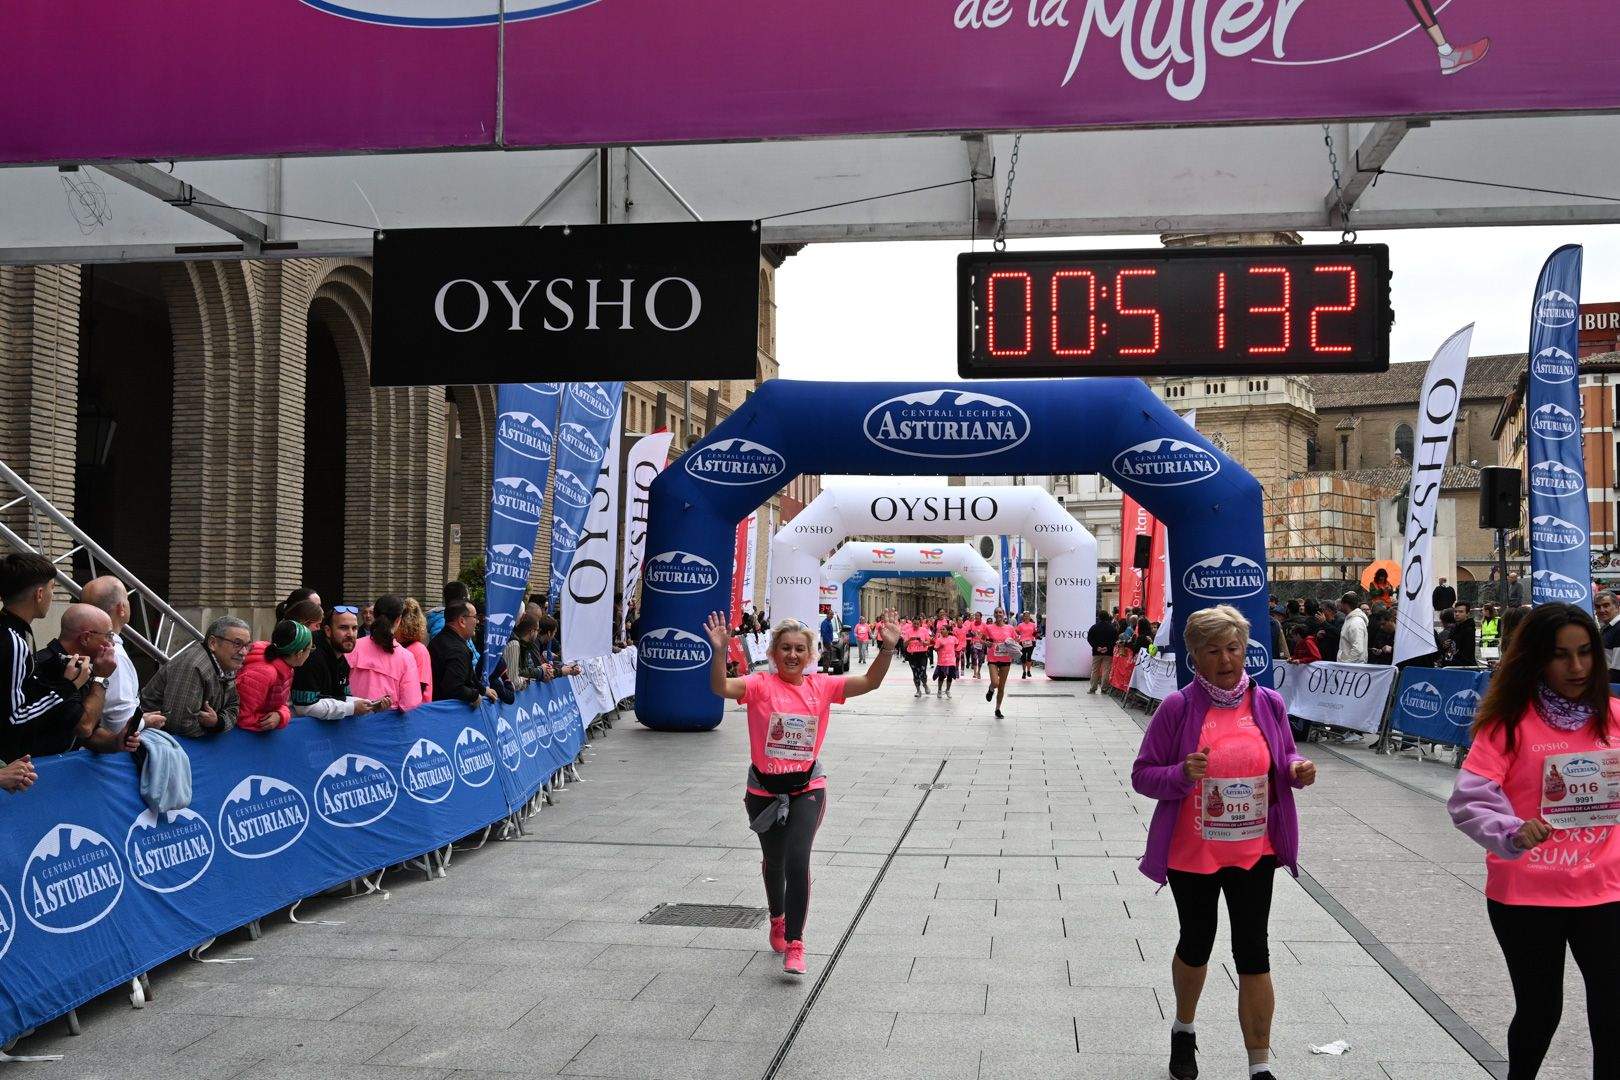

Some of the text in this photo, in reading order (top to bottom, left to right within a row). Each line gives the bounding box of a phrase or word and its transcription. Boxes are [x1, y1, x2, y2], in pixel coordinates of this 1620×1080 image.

[434, 276, 702, 333] OYSHO
[1535, 361, 1573, 375] ASTURIANA
[571, 383, 610, 416] ASTURIANA
[901, 409, 1012, 418] CENTRAL LECHERA
[1533, 415, 1572, 432] ASTURIANA
[875, 410, 1018, 441] ASTURIANA
[559, 427, 598, 460] ASTURIANA
[690, 454, 778, 475] ASTURIANA
[1121, 457, 1214, 475] ASTURIANA
[554, 482, 587, 505] STURIANA
[1404, 377, 1457, 602] OYSHO
[491, 493, 541, 517] ASTURIAN
[870, 496, 998, 522] OYSHO
[794, 525, 833, 534] OYSHO
[1034, 524, 1073, 533] OYSHO
[1533, 532, 1579, 545] STURIANA
[645, 565, 713, 585] ASTURIANA
[776, 576, 812, 585] OYSHO
[1054, 577, 1091, 587] OYSHO
[1188, 572, 1262, 590] ASTURIANA
[1533, 587, 1580, 599] STURIANA
[639, 641, 706, 661] ASTURIANA
[1308, 667, 1372, 699] OYSHO
[1404, 692, 1438, 712] ASTURIANA
[785, 731, 802, 739] 016
[1531, 741, 1569, 752] OYSHO
[458, 751, 494, 776] ASTURIANA
[409, 765, 453, 792] ASTURIANA
[1569, 782, 1599, 794] 016
[323, 781, 395, 816] ASTURIANA
[1226, 802, 1250, 812] 016
[235, 803, 265, 818] CENTRAL
[227, 805, 306, 847] ASTURIANA
[142, 832, 171, 846] CENTRAL
[42, 848, 109, 880] CENTRAL LECHERA
[134, 835, 210, 877] ASTURIANA
[31, 862, 121, 919] ASTURIANA
